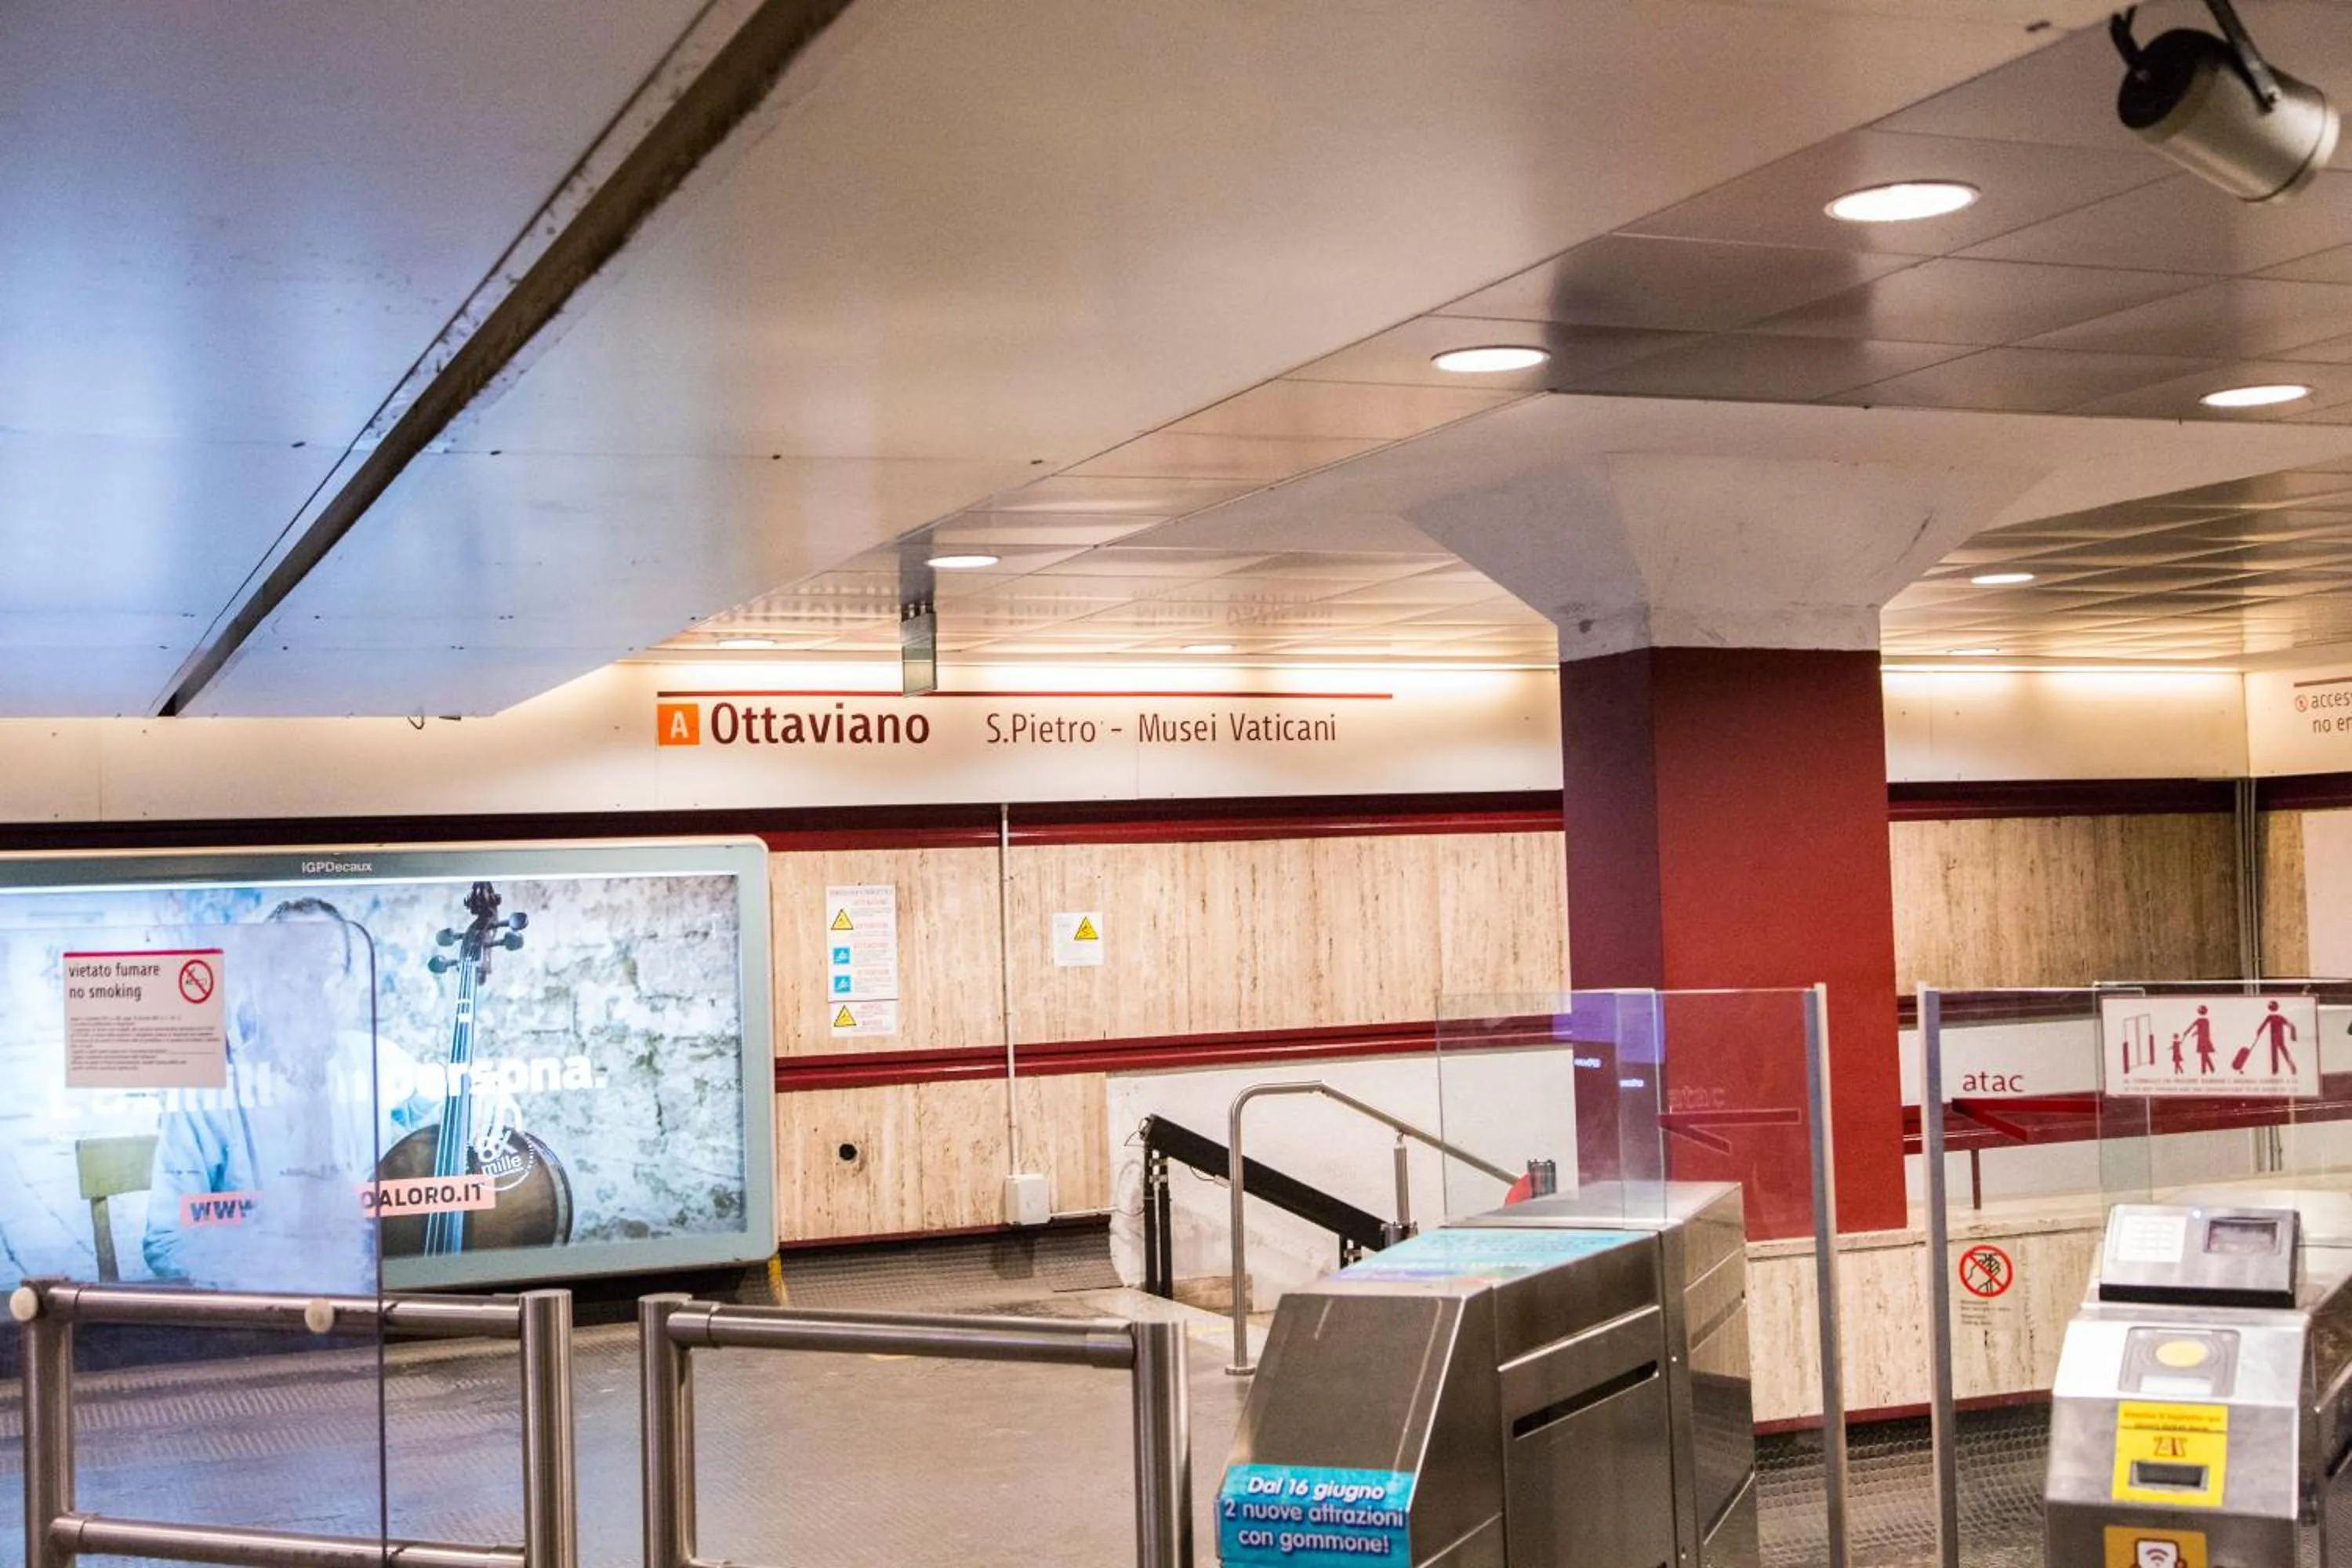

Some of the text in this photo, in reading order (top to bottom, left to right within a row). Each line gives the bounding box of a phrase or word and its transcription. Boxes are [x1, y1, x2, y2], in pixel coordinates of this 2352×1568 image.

[711, 702, 931, 745] Ottaviano
[986, 713, 1096, 743] S.Pietro
[1139, 713, 1217, 743] Musei
[1229, 713, 1337, 742] Vaticani
[2312, 718, 2332, 734] no
[301, 861, 373, 873] IGPDecaux
[68, 962, 161, 978] vietato fumare
[69, 984, 142, 1002] no smoking
[1962, 1071, 2025, 1093] atac
[481, 1153, 522, 1175] mille
[1247, 1476, 1385, 1502] Dal 16 giugno
[1224, 1498, 1403, 1527] 2 nuove attrazioni
[1238, 1529, 1390, 1554] con gommone!
